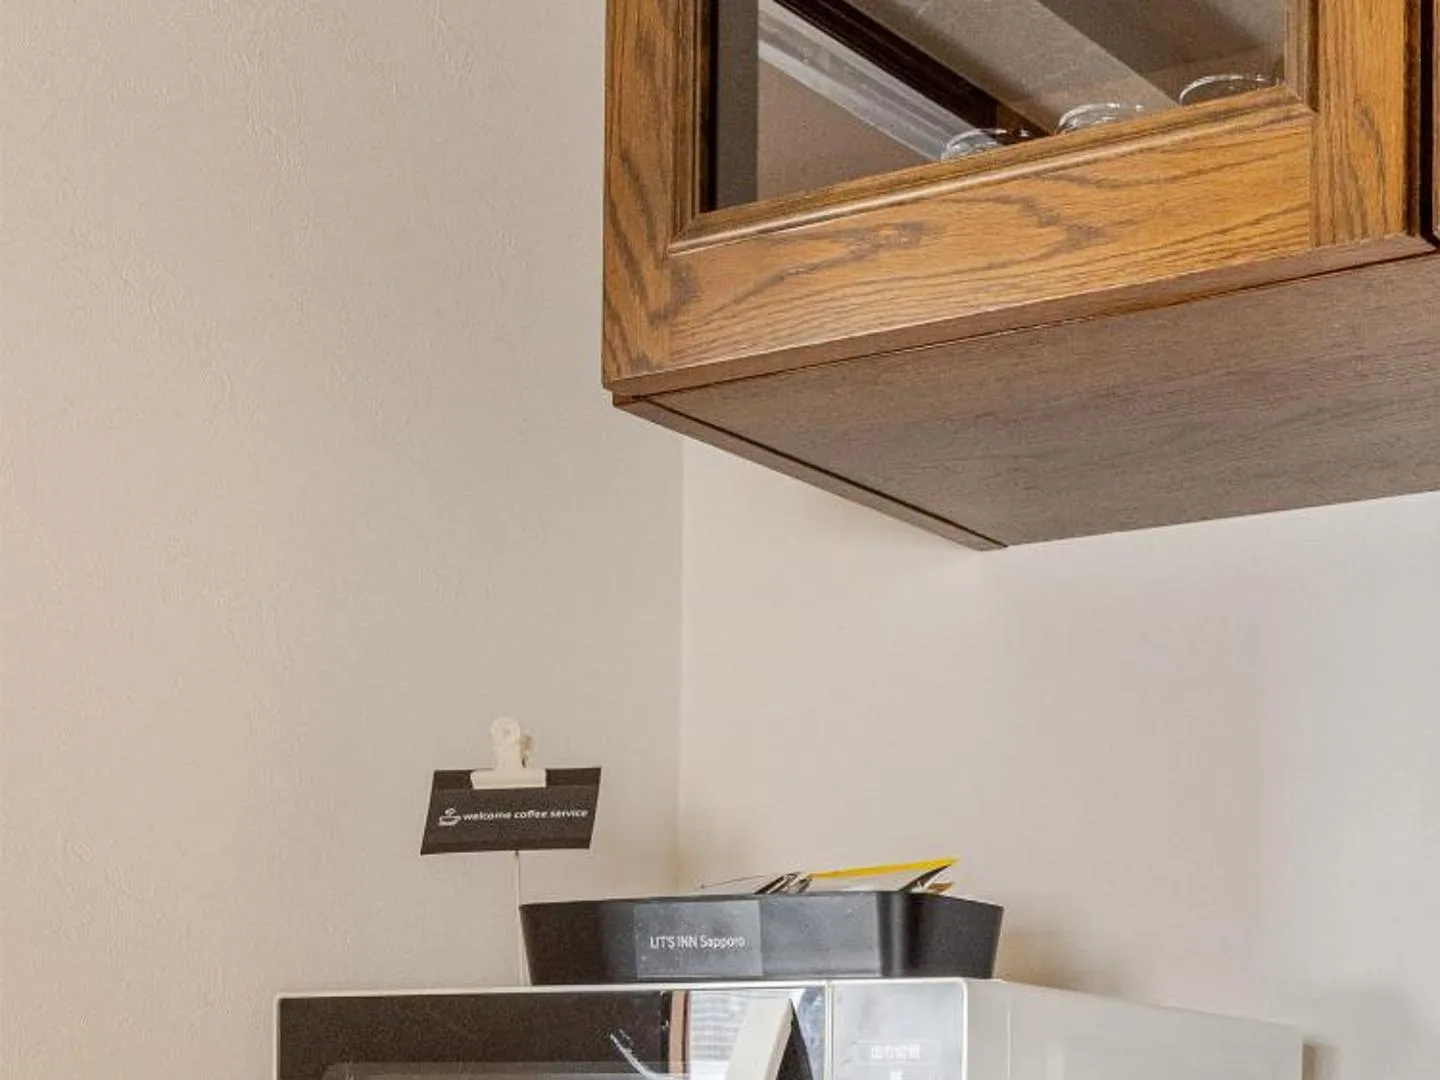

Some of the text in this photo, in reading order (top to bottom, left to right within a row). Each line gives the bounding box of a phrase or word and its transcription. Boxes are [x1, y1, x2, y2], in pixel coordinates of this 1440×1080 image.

[463, 809, 588, 821] welcome coffee service
